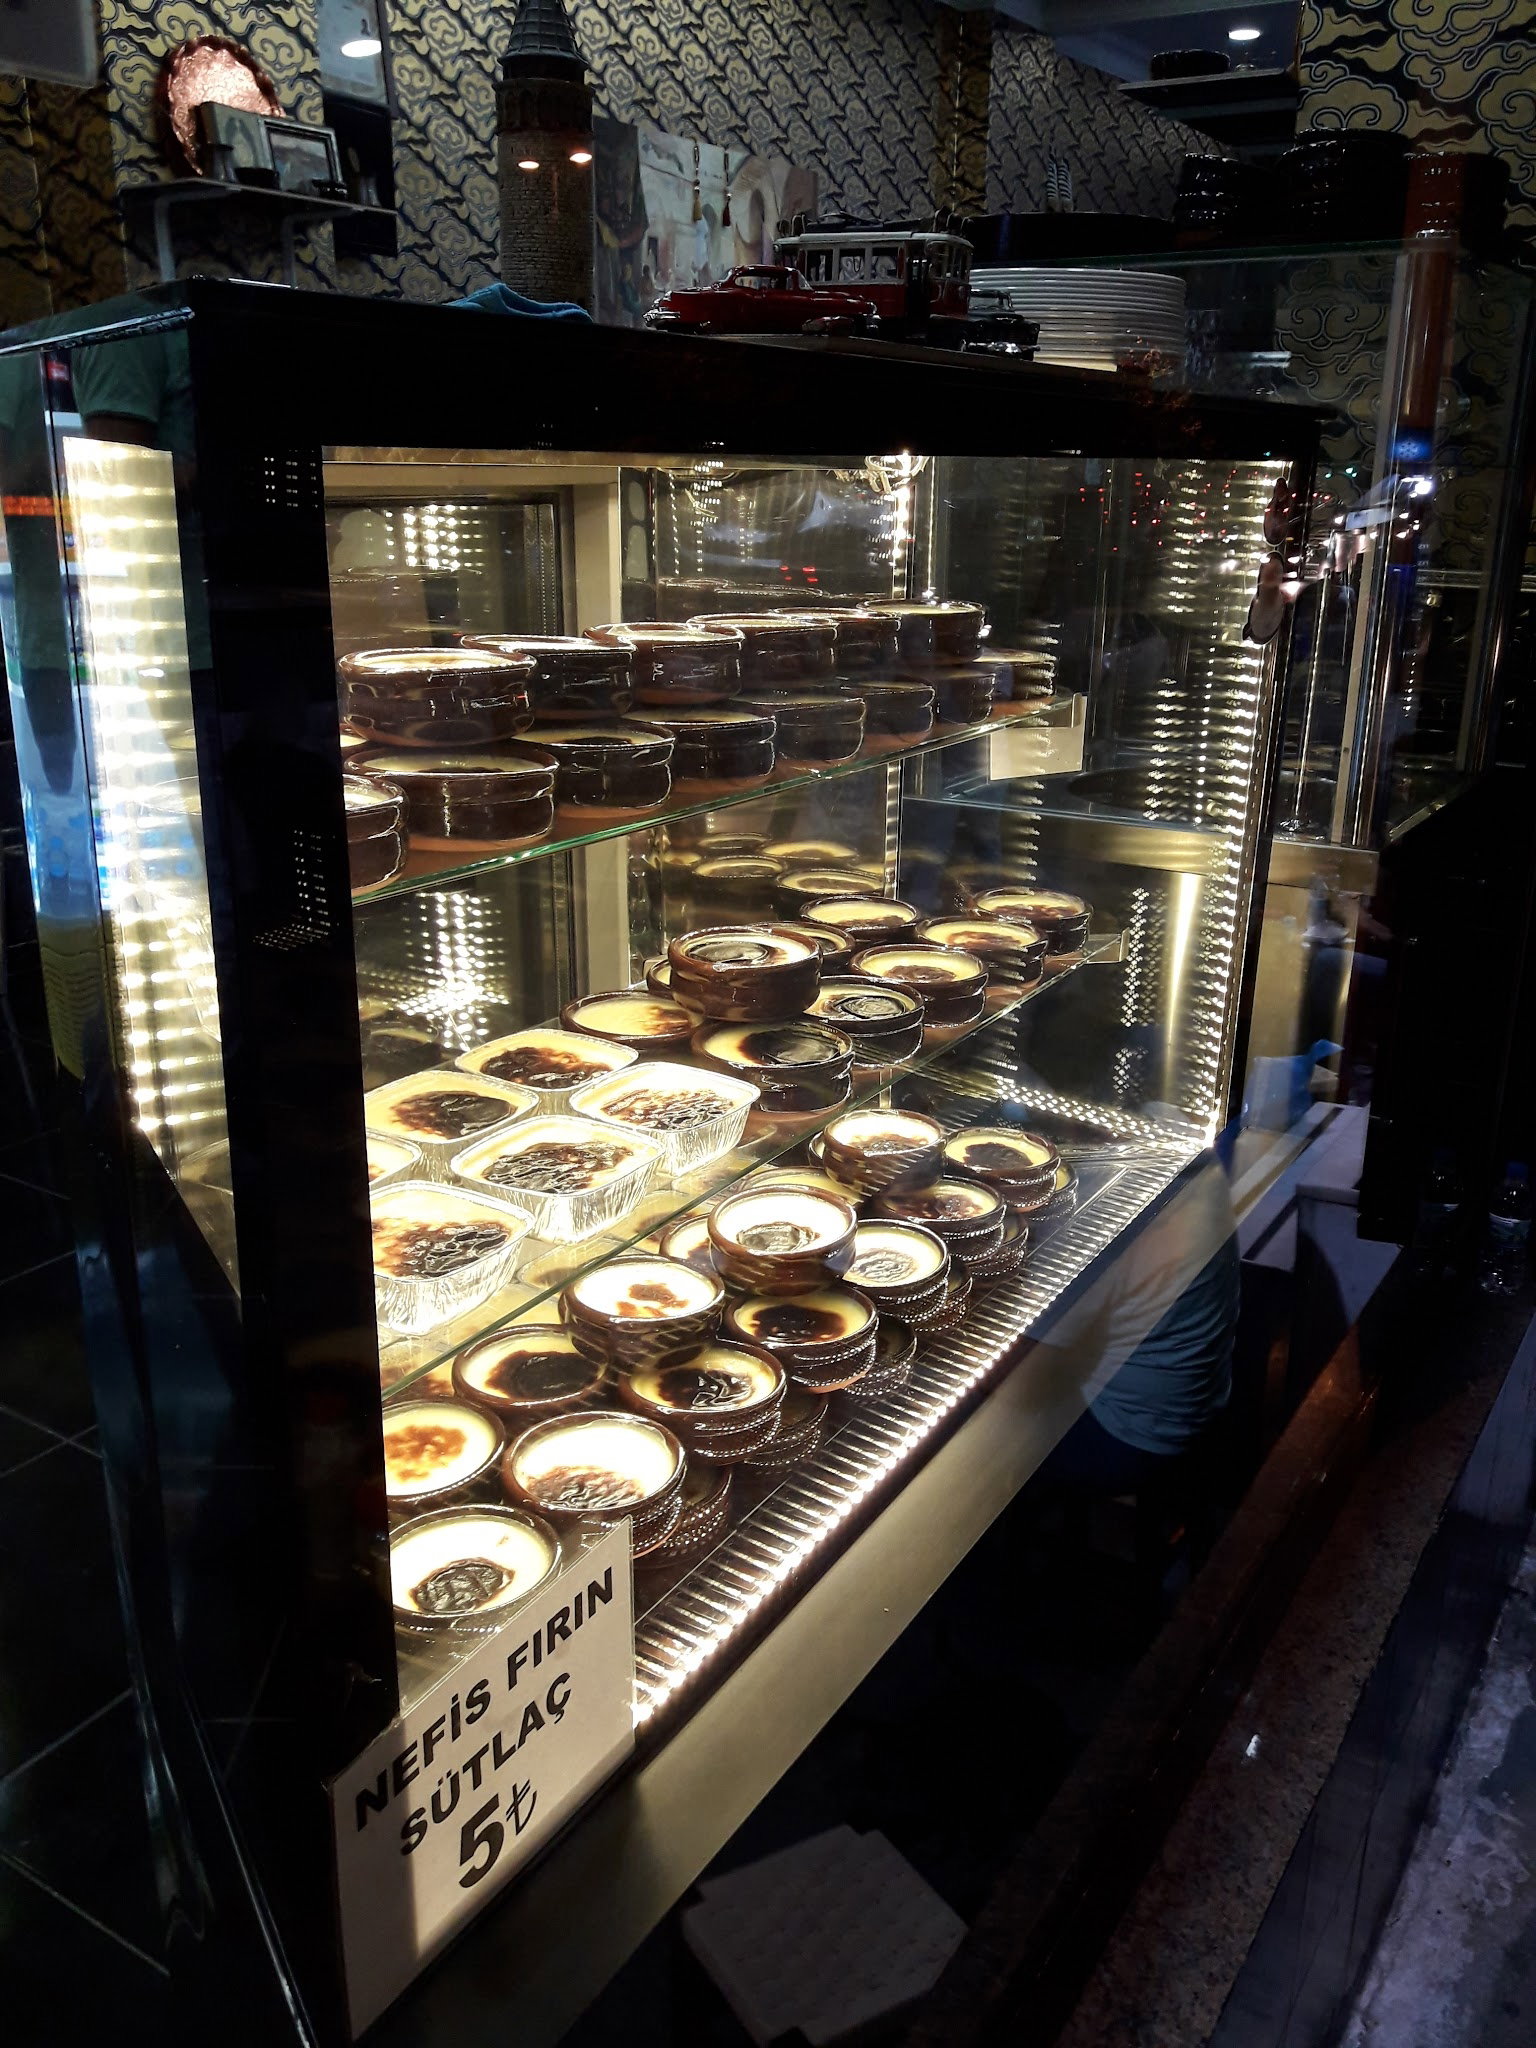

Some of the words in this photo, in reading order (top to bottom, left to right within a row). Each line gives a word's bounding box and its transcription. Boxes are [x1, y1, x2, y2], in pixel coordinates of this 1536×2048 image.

[356, 1678, 490, 1831] NEFİS
[507, 1567, 613, 1691] FIRIN
[401, 1673, 571, 1855] SÜTLAÇ
